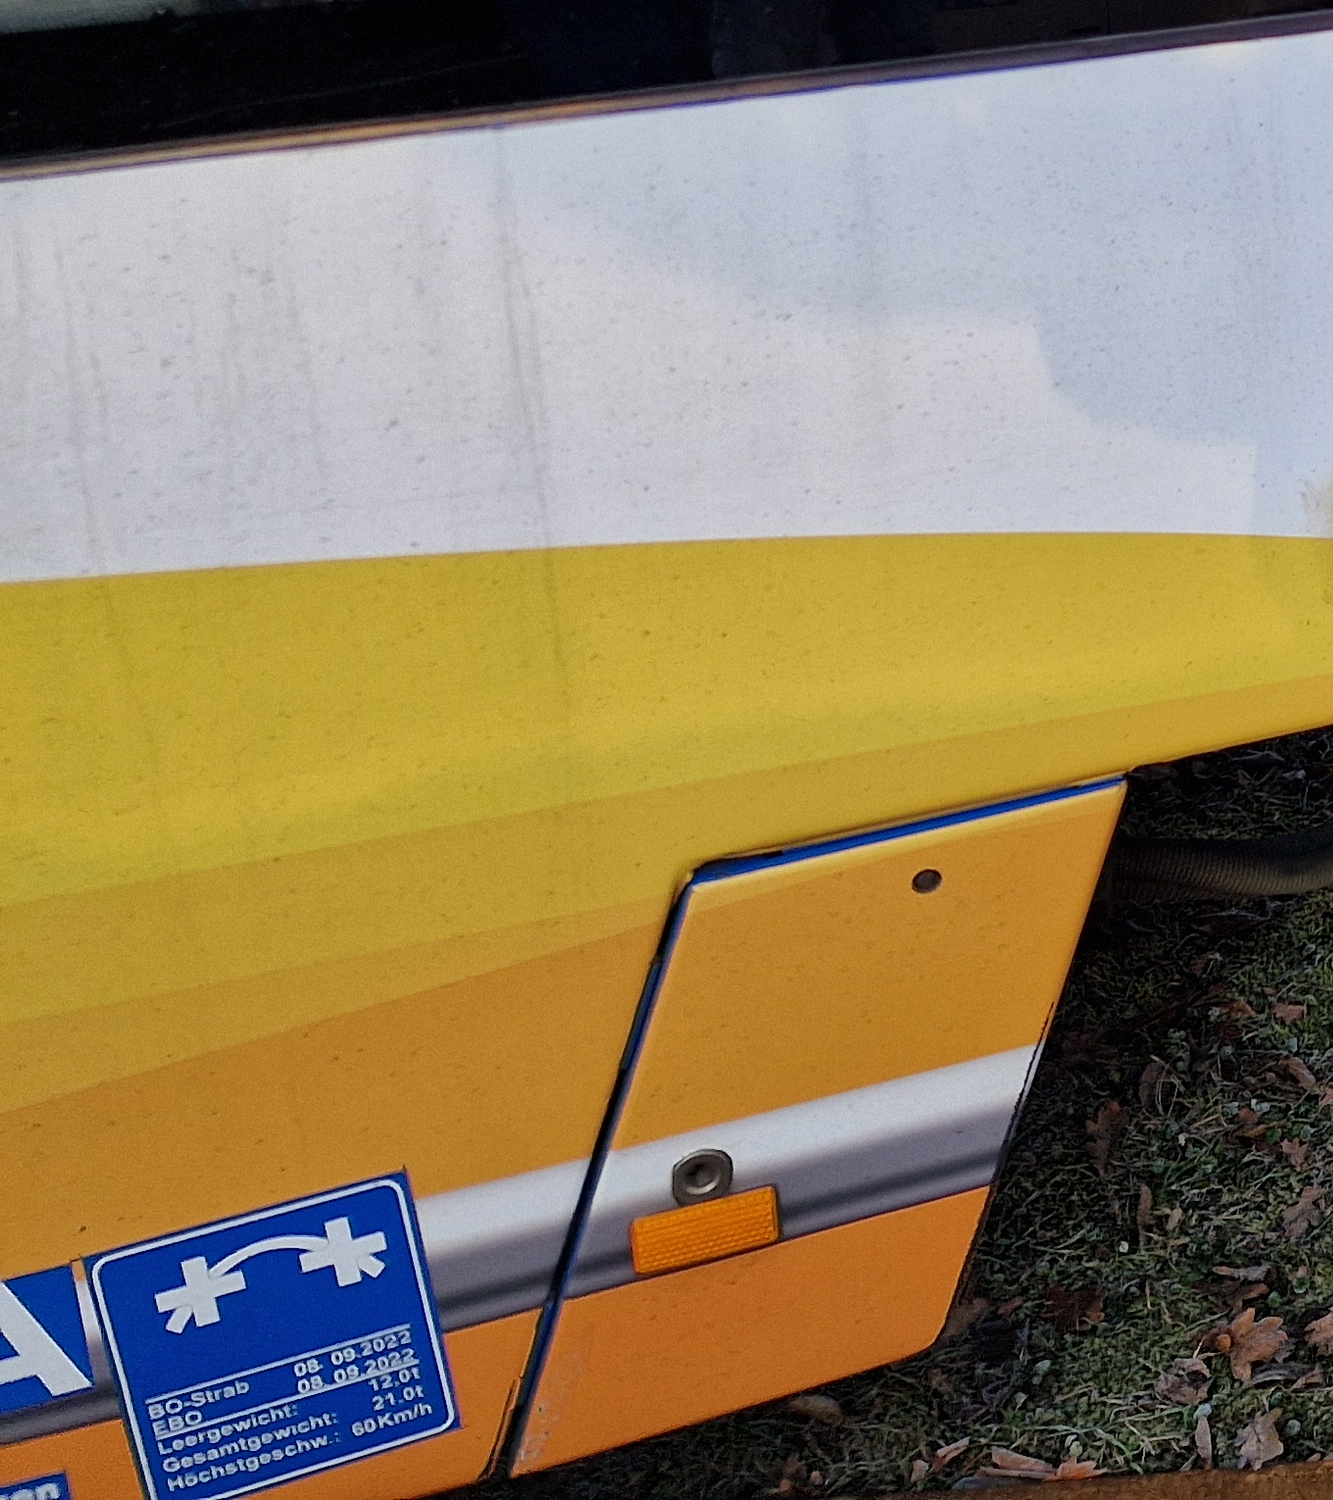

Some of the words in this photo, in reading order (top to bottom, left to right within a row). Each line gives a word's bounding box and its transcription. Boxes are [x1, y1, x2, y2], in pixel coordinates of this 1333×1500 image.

[148, 1380, 251, 1420] BO-Strab
[152, 1409, 204, 1436] EBO
[157, 1404, 298, 1455] Leergewicht:
[163, 1411, 338, 1473] Gesamtgewicht:
